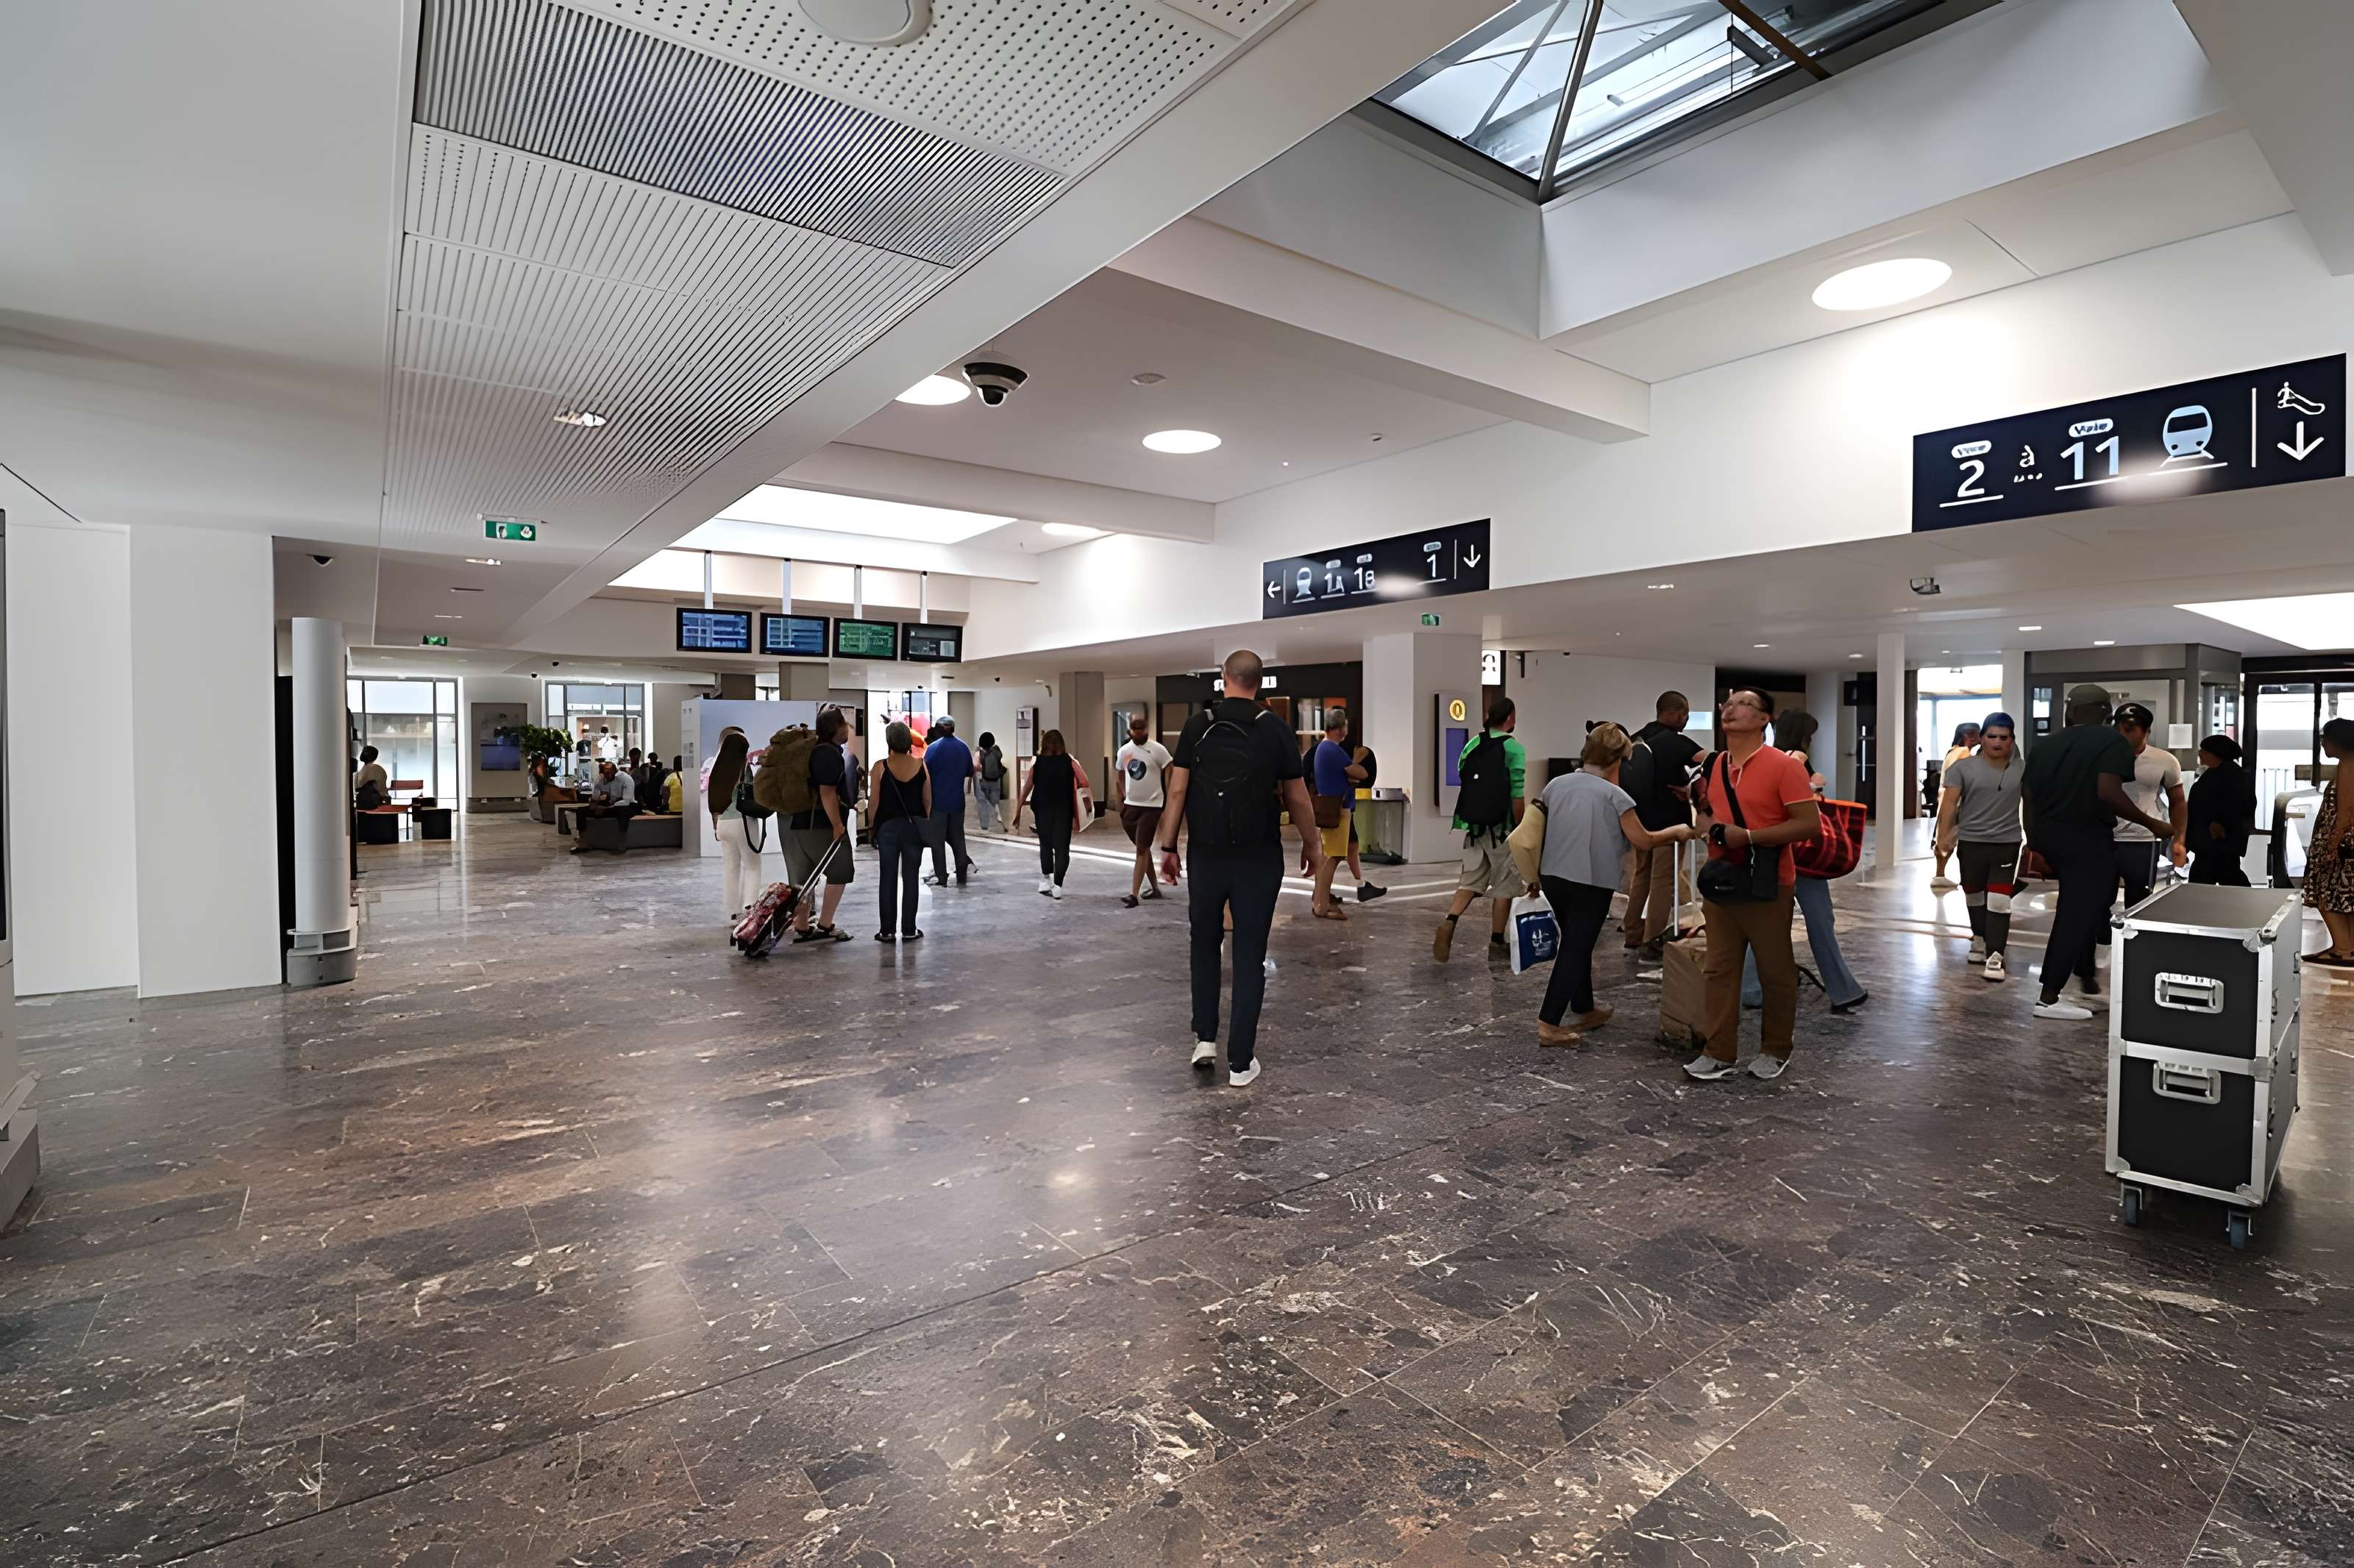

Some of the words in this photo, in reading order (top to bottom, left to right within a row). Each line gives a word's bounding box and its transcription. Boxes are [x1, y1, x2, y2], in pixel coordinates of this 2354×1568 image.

[1957, 460, 1985, 497] 2
[2019, 444, 2035, 467] à
[2060, 435, 2119, 480] 11
[1324, 573, 1345, 594] 1A
[1427, 554, 1436, 577] 1
